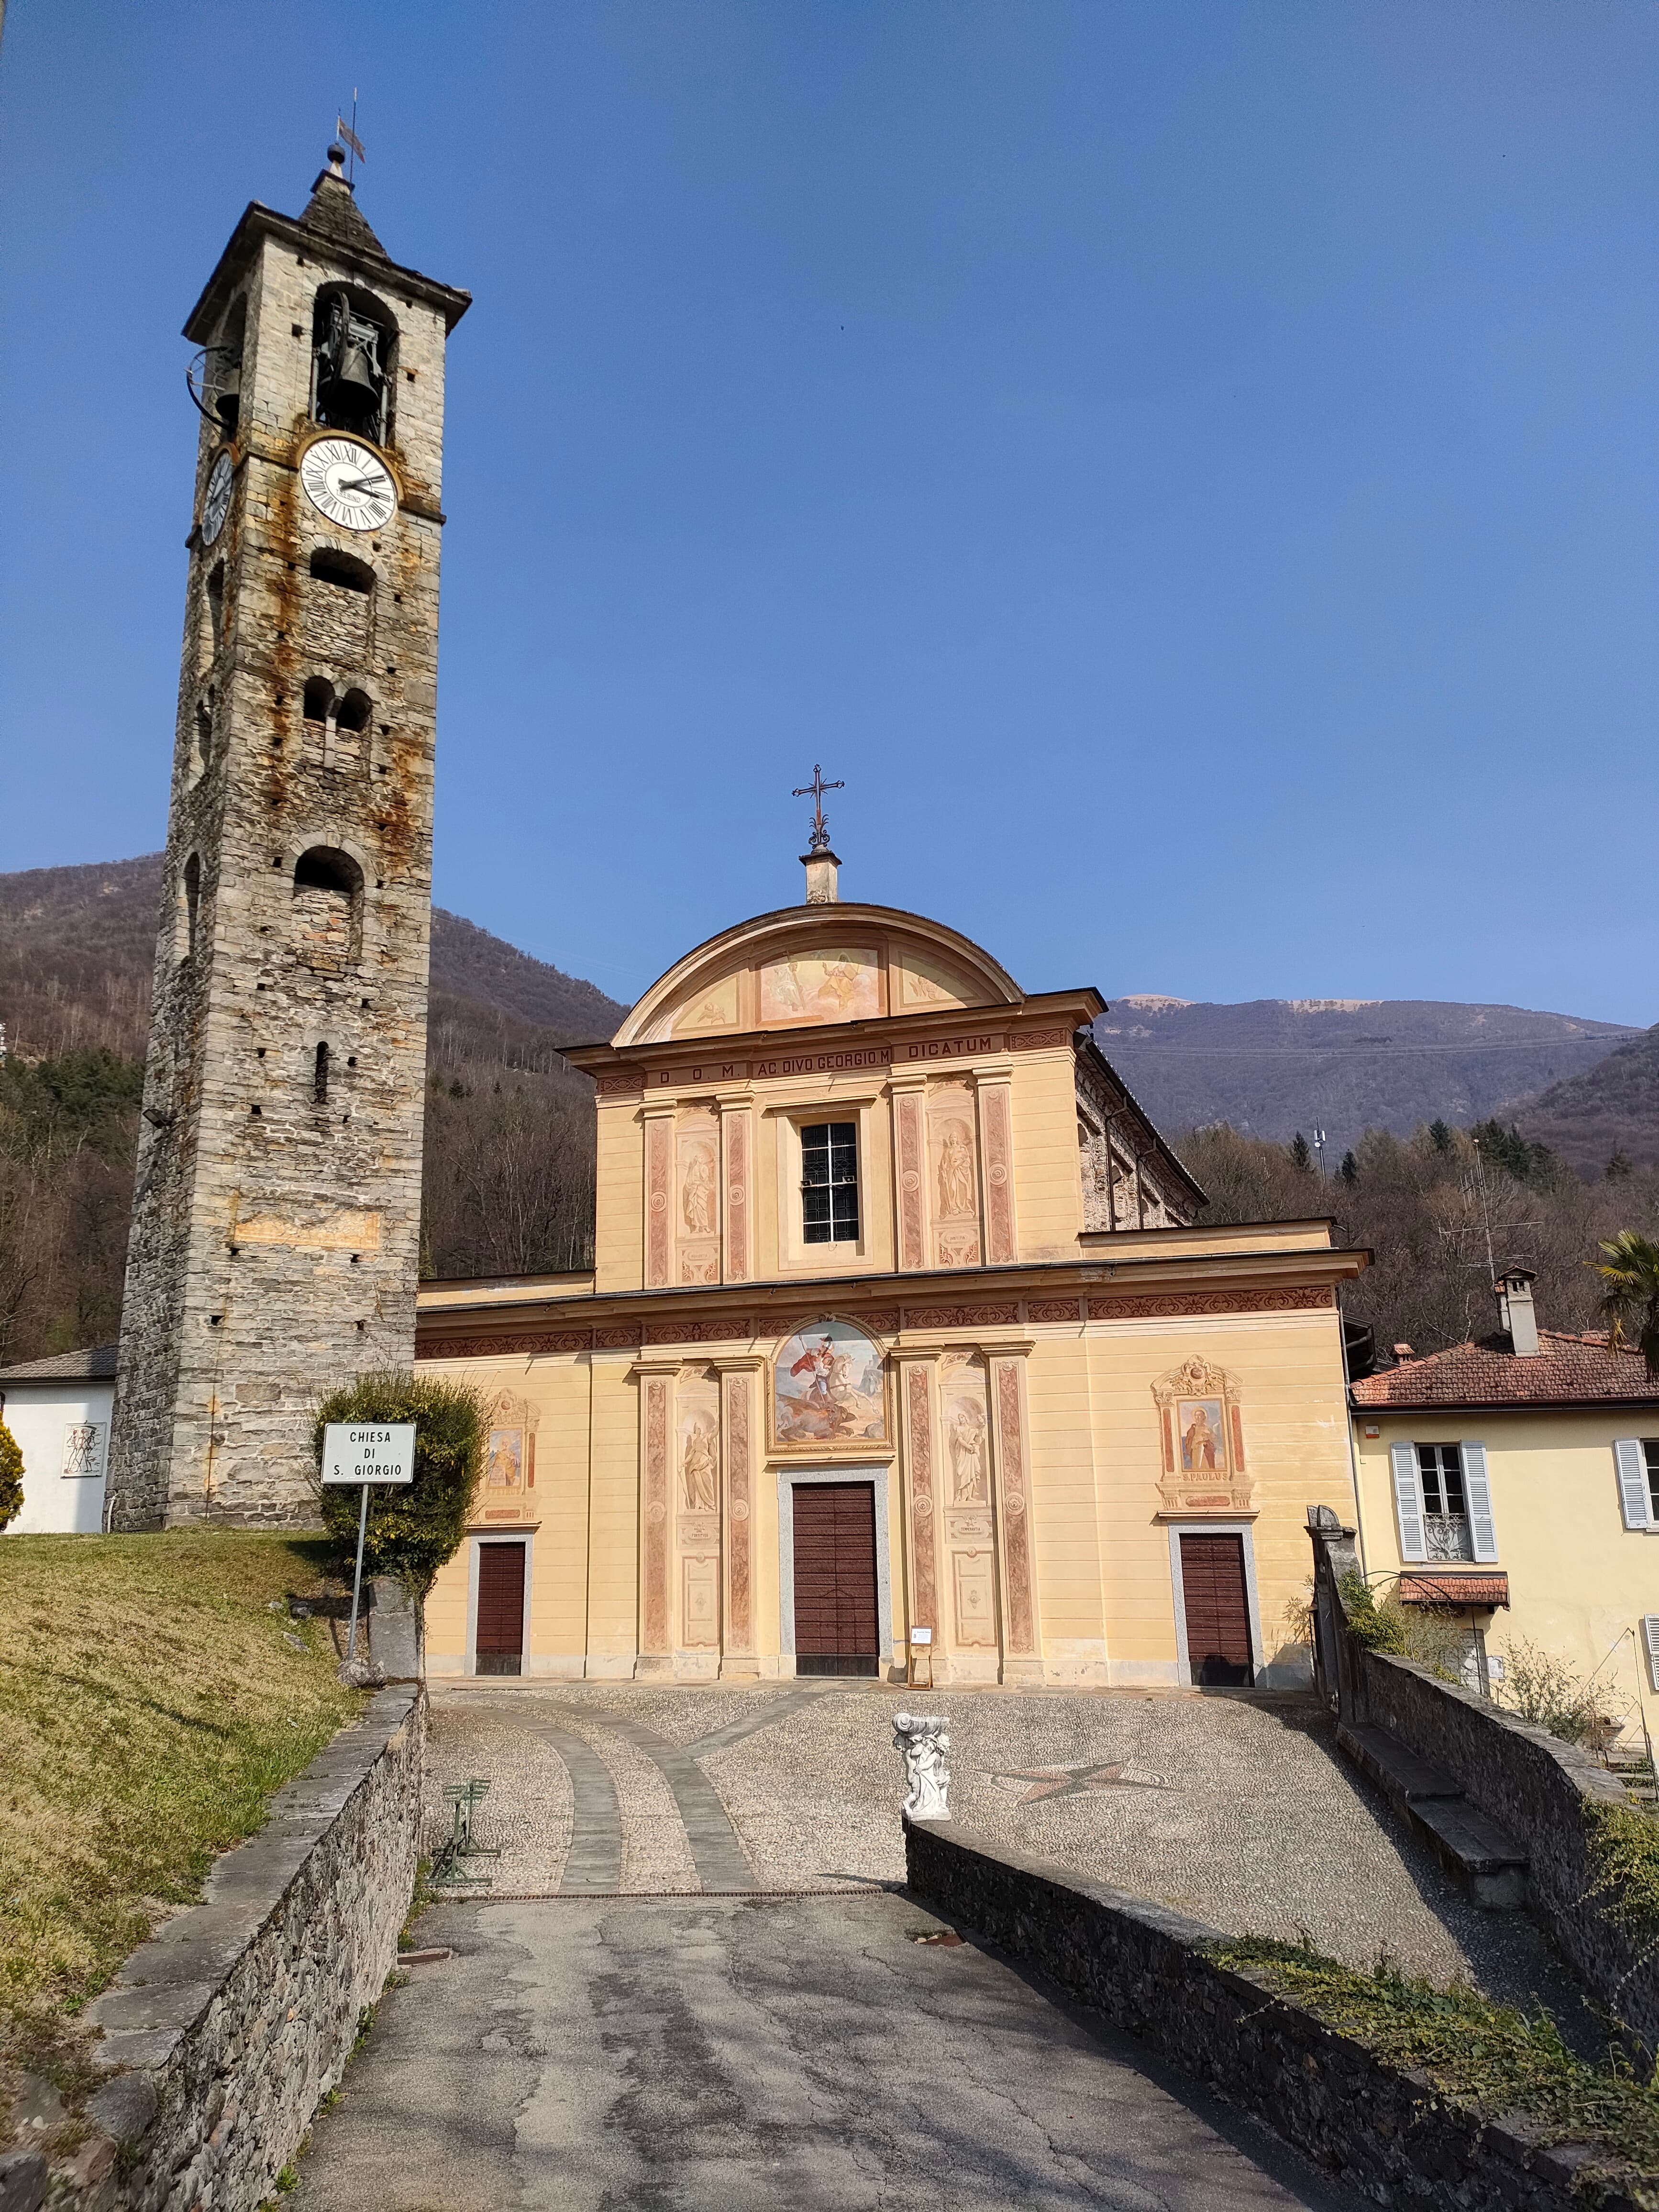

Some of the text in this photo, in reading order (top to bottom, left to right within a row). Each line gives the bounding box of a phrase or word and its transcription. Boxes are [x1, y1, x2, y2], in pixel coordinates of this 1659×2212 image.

[343, 444, 356, 465] XII
[908, 1037, 992, 1058] DICATUM
[350, 1431, 391, 1443] CHIESA
[364, 1448, 376, 1459] DI
[333, 1464, 402, 1476] S. GIORGIO
